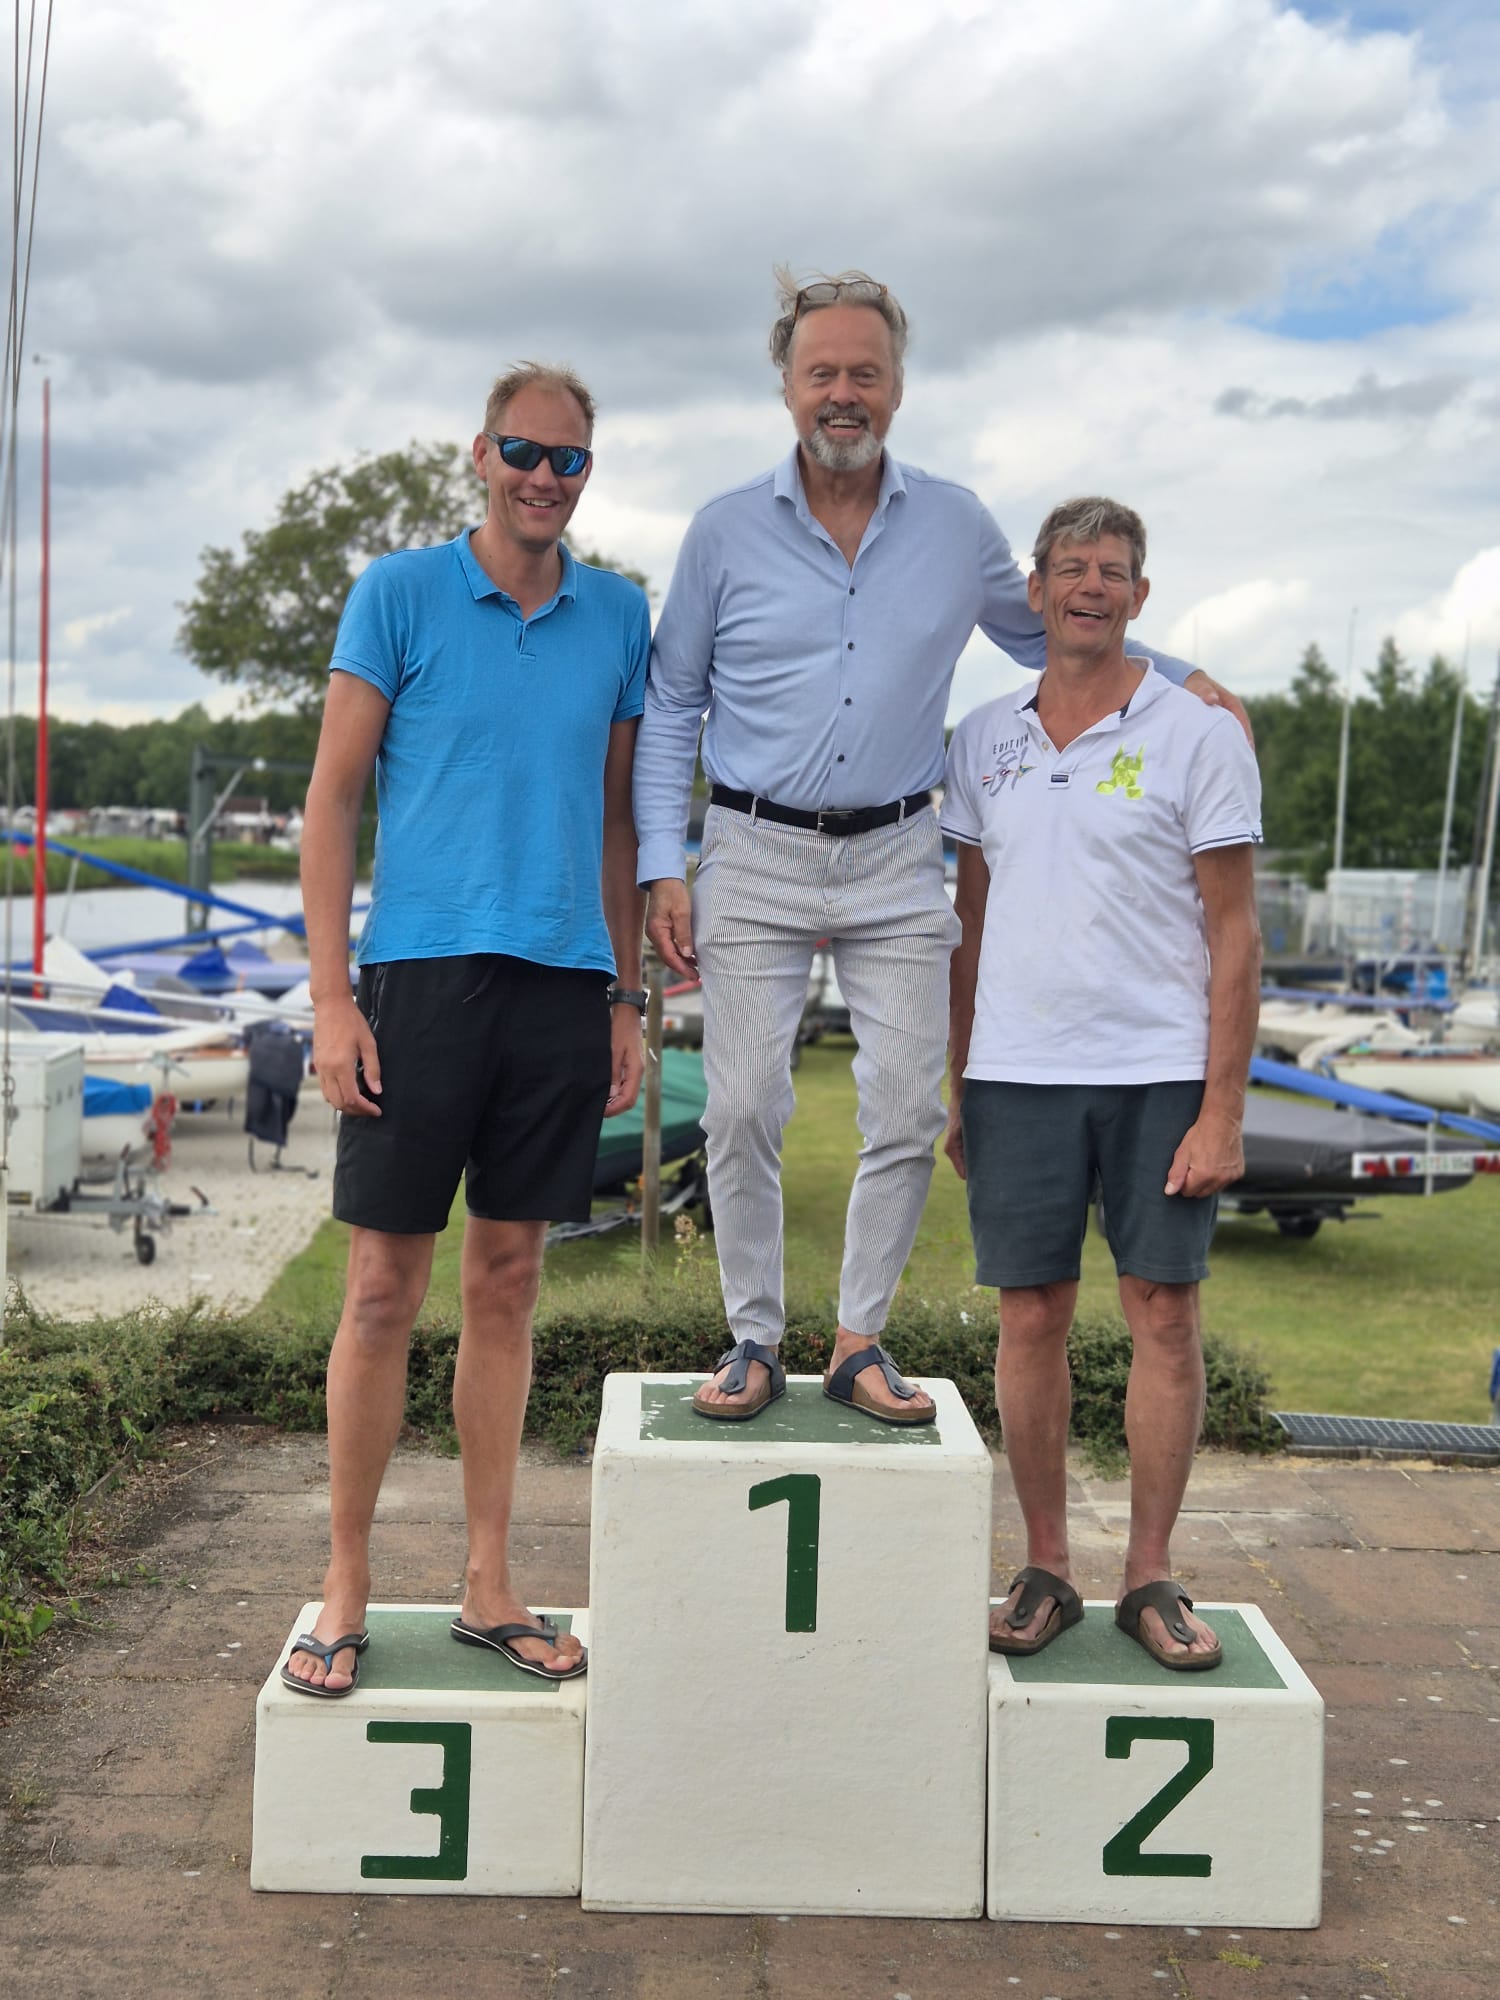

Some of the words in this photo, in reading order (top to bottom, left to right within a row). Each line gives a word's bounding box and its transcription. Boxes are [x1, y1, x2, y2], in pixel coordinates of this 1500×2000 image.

[749, 1475, 819, 1631] 1
[362, 1722, 471, 1879] 3
[1103, 1717, 1215, 1876] 2
